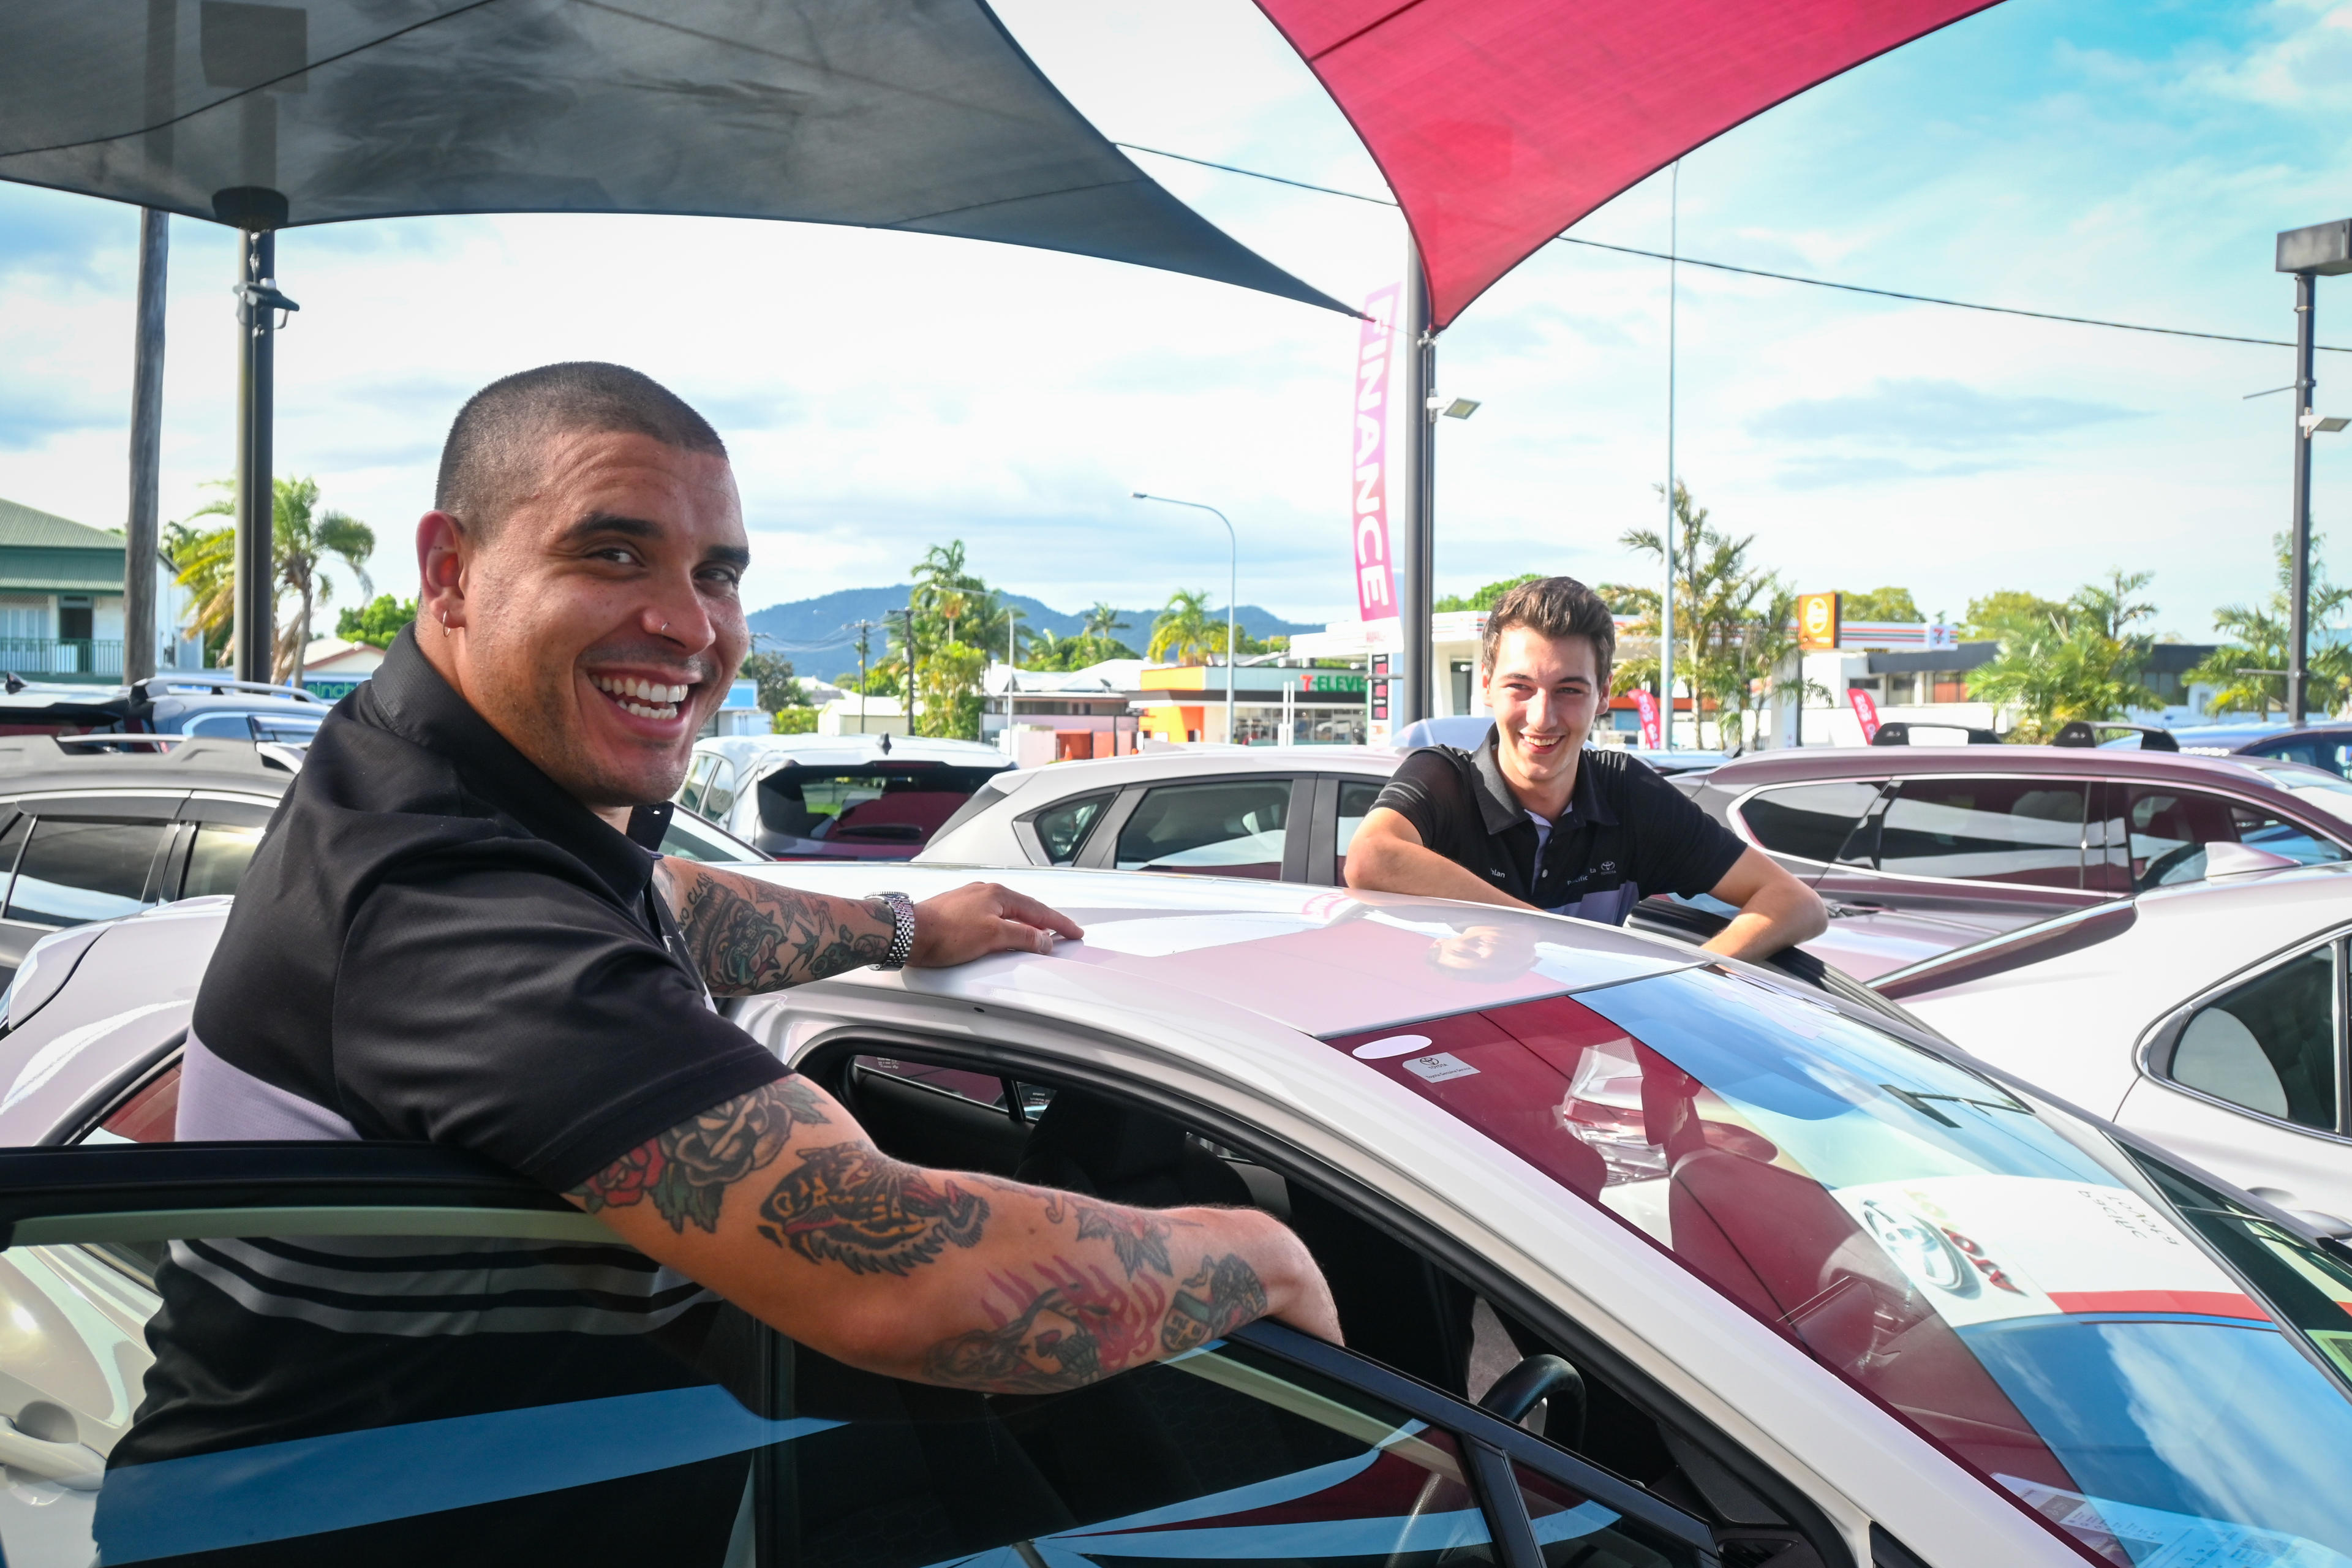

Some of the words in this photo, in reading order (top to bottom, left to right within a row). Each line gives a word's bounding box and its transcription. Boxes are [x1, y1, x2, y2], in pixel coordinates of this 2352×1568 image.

[1355, 294, 1395, 608] FINANCE
[1300, 675, 1366, 692] 7-ELEVE
[1853, 694, 1872, 722] NOW
